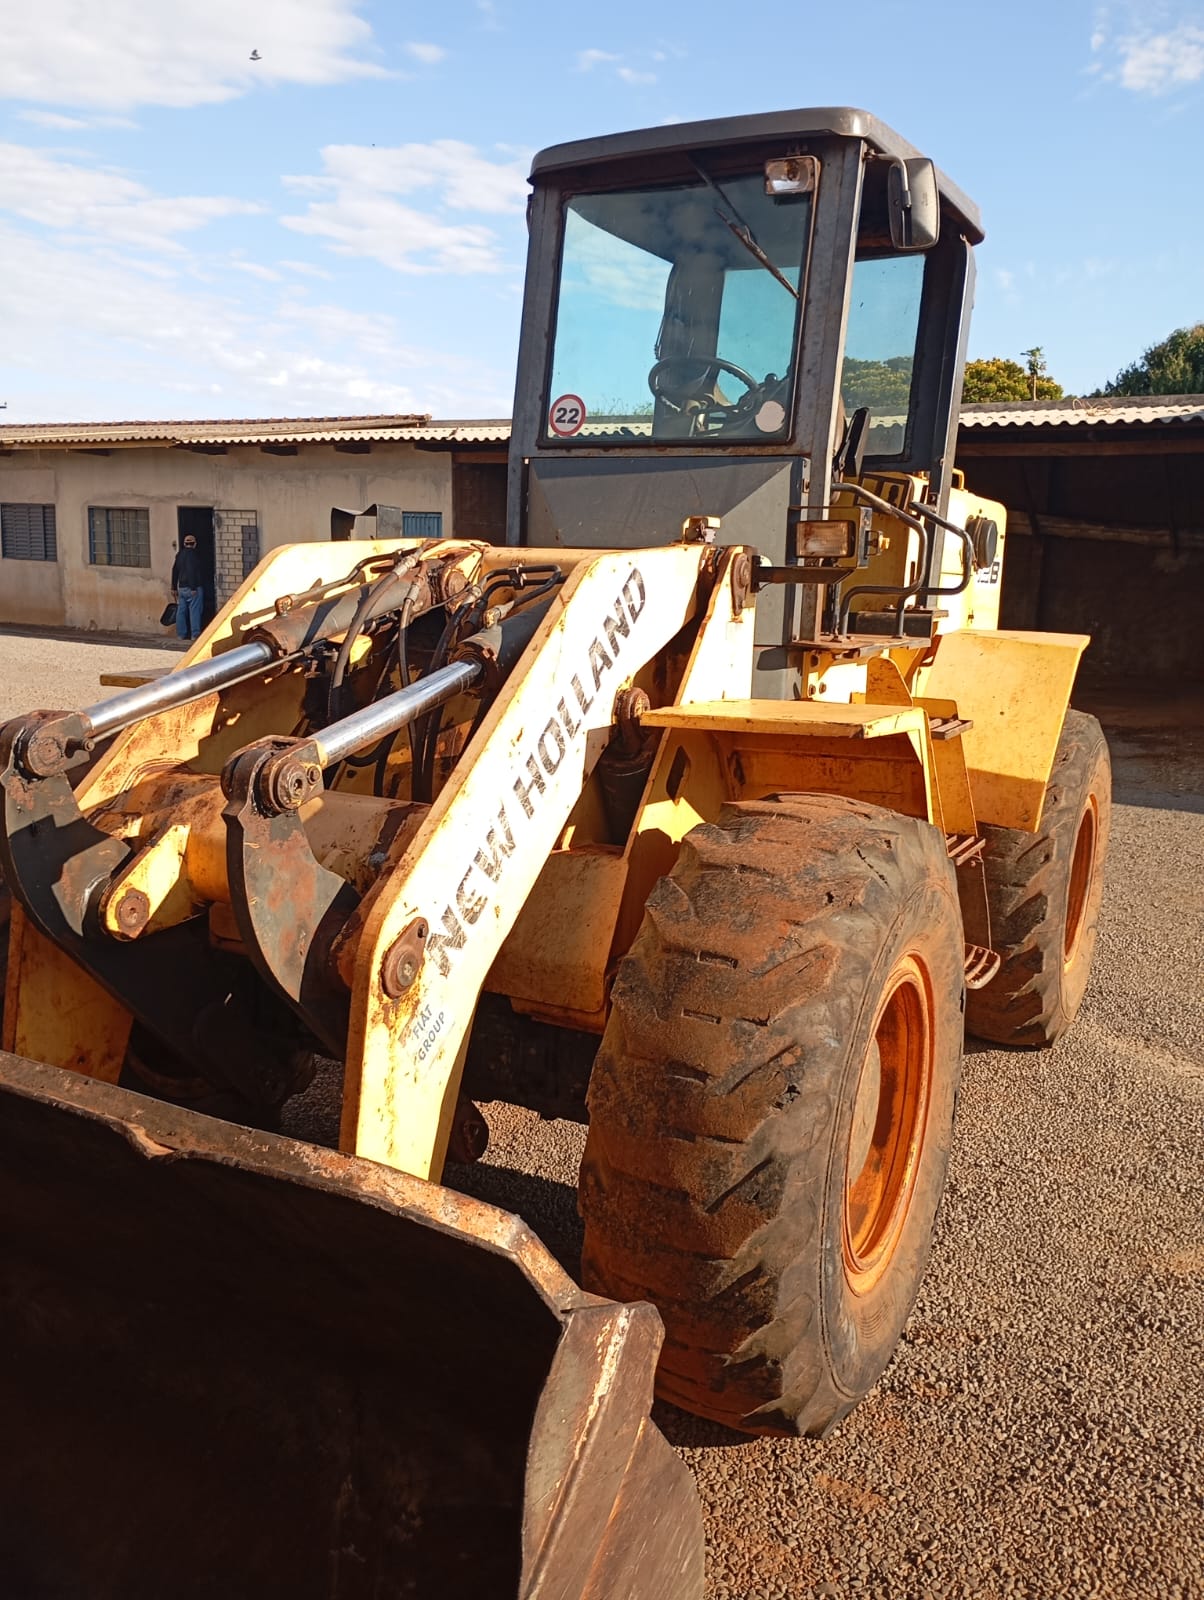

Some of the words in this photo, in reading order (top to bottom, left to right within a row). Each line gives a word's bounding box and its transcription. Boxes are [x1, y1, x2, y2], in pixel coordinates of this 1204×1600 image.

[554, 407, 580, 424] 22
[426, 798, 517, 979] NEW
[512, 567, 646, 820] HOLLAND
[412, 1004, 433, 1040] FIAT
[417, 1011, 446, 1061] GROUP
